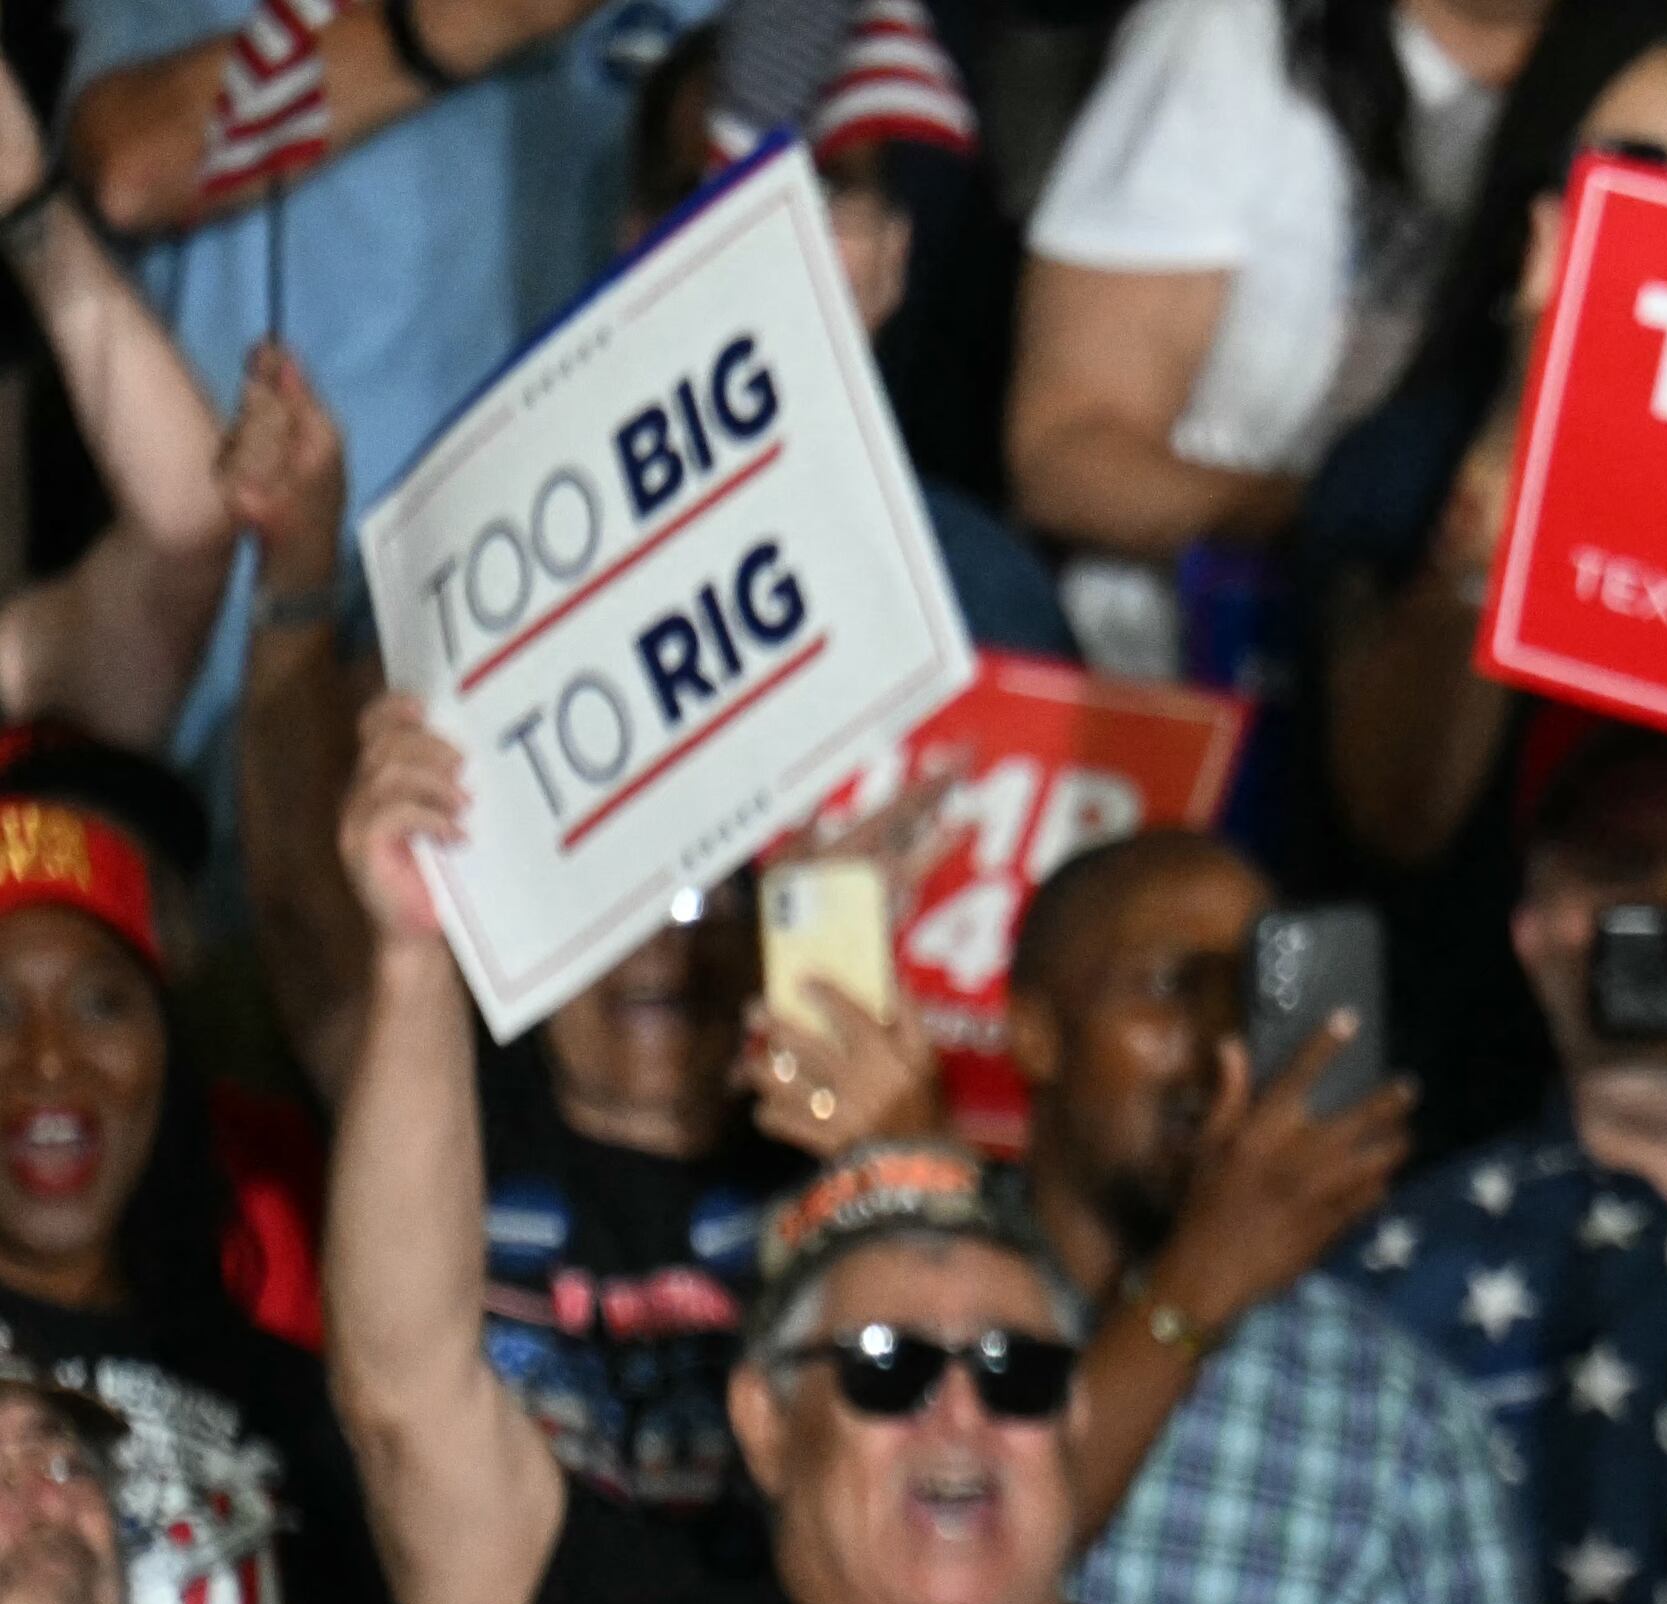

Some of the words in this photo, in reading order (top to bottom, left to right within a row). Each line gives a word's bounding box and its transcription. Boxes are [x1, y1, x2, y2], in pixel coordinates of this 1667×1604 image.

[424, 466, 604, 668] TOO
[610, 330, 782, 520] BIG
[500, 670, 634, 818] TO
[634, 537, 808, 726] RIG
